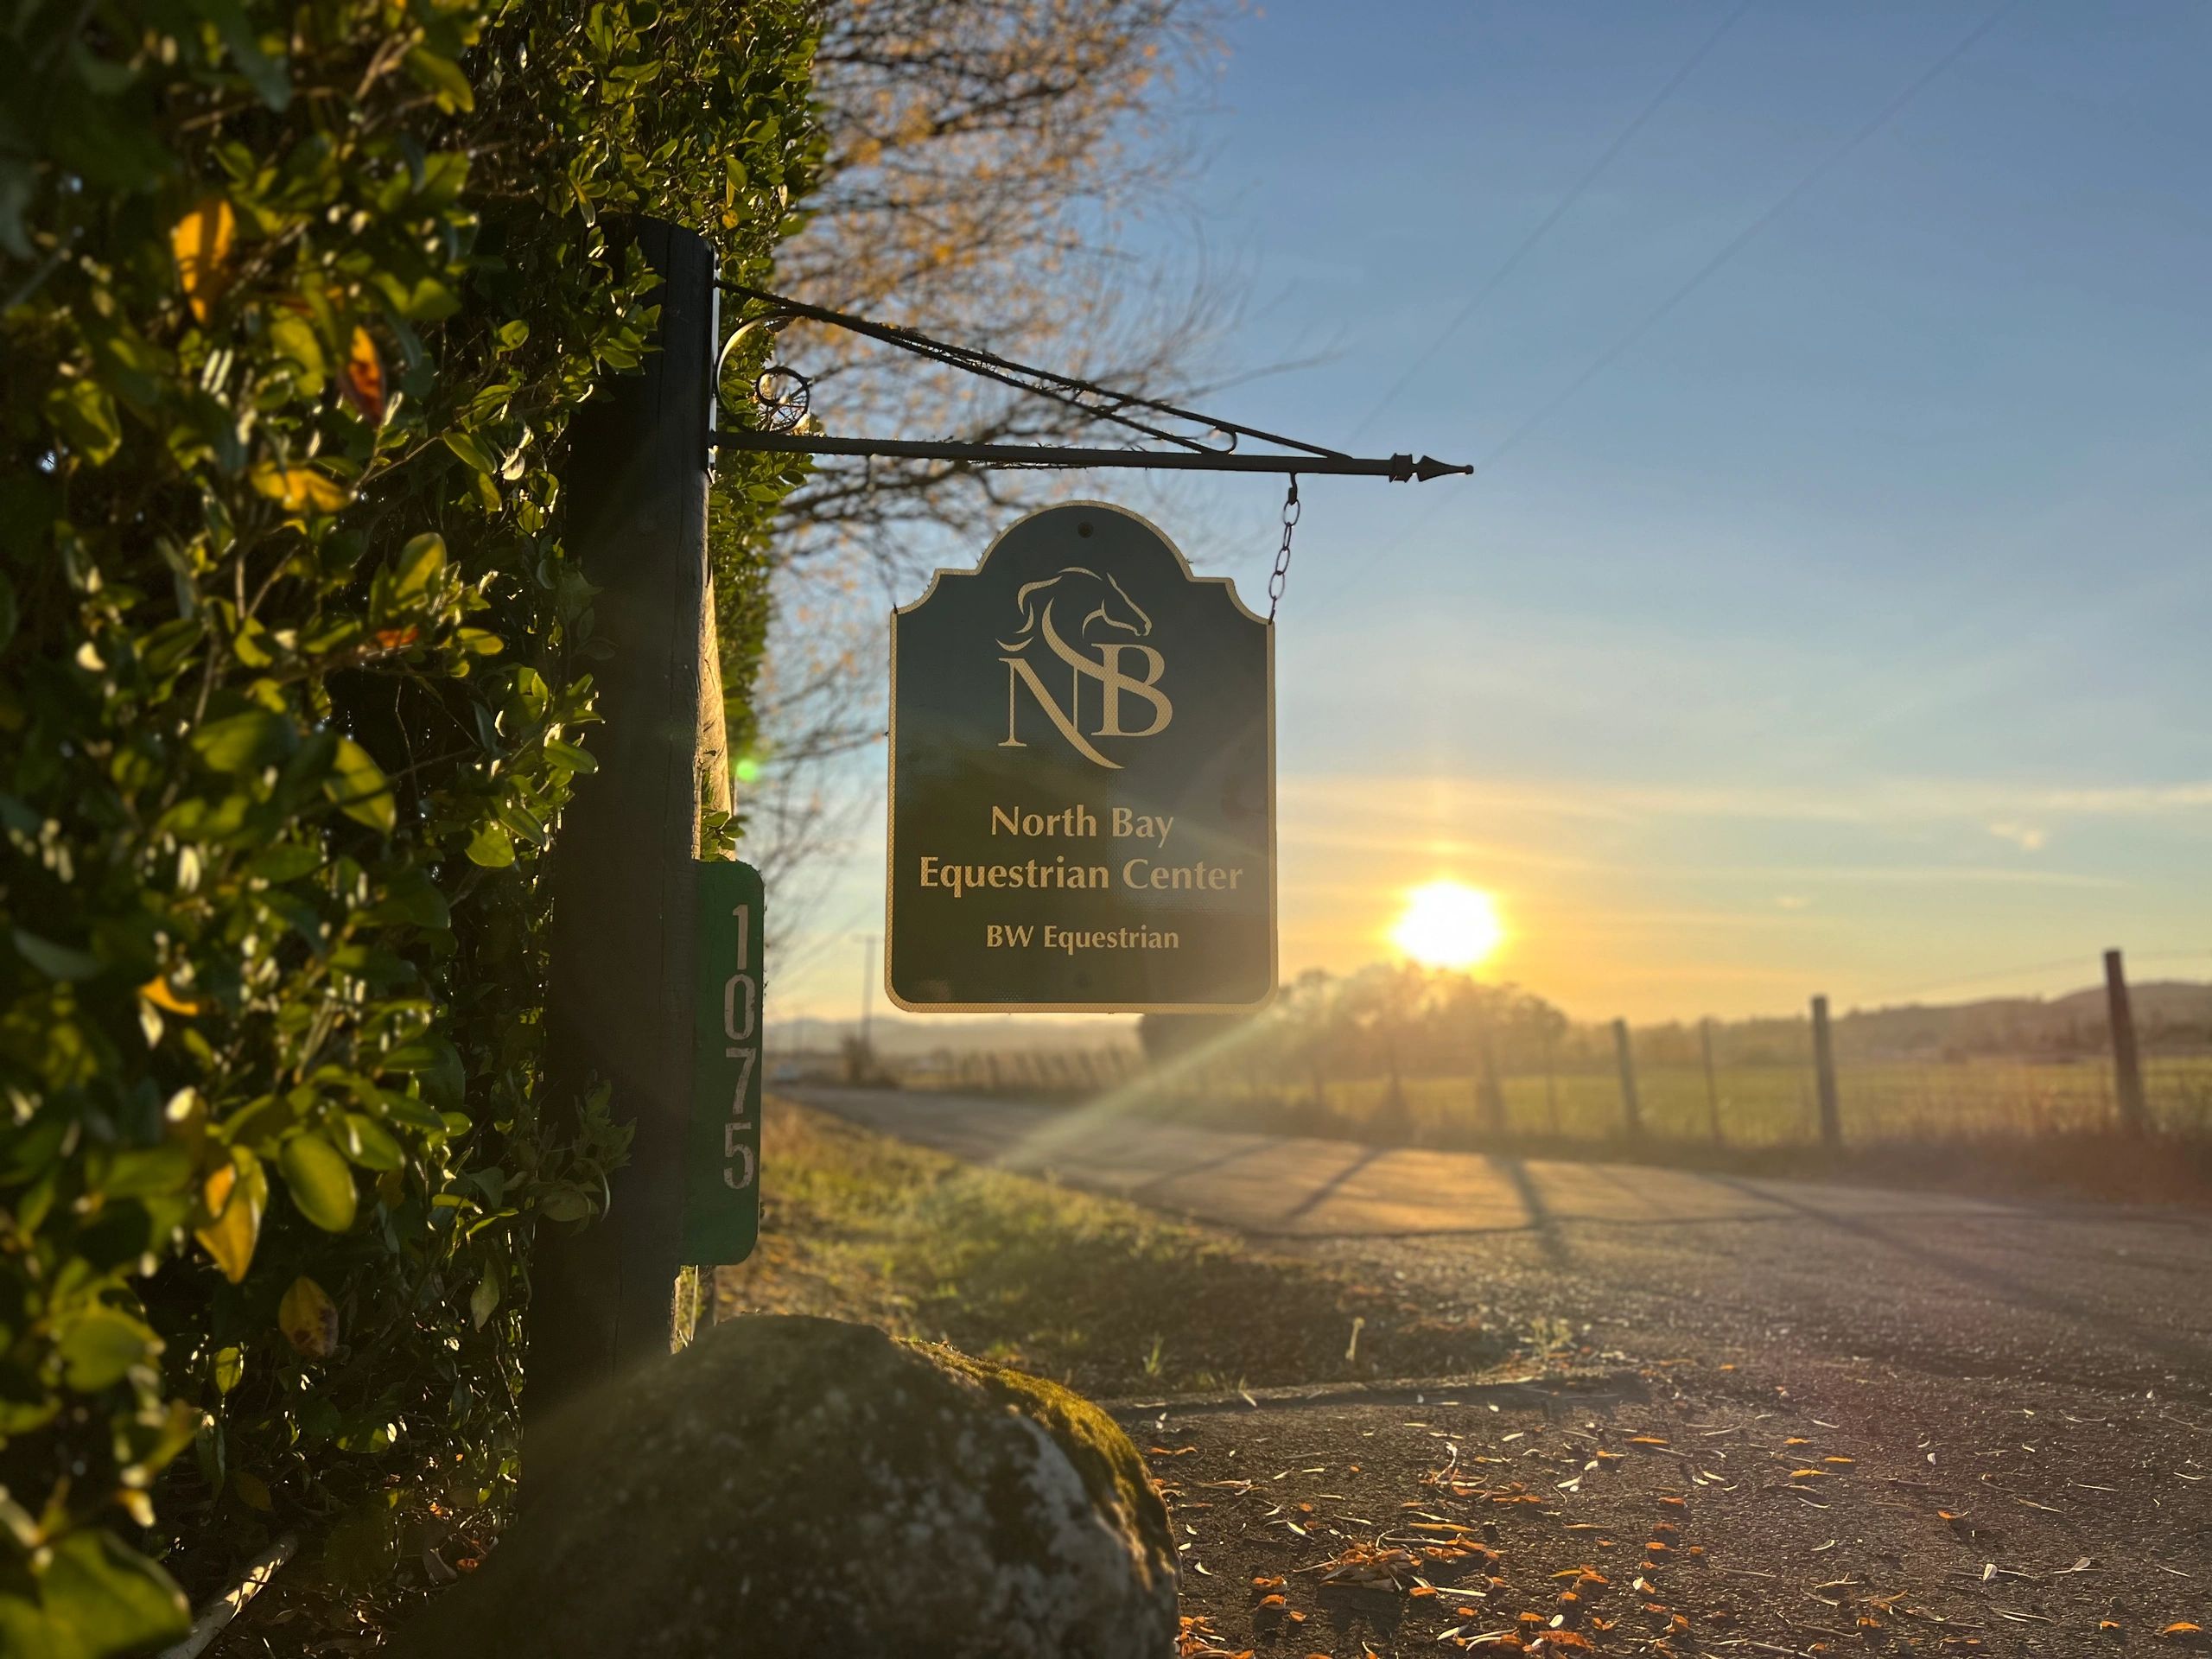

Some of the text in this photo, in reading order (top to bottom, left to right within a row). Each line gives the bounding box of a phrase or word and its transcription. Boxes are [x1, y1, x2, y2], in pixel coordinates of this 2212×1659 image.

[991, 804, 1175, 848] North Bay
[920, 856, 1243, 898] Equestrian Center
[987, 925, 1179, 955] BW Equestrian
[723, 904, 757, 1189] 1075
